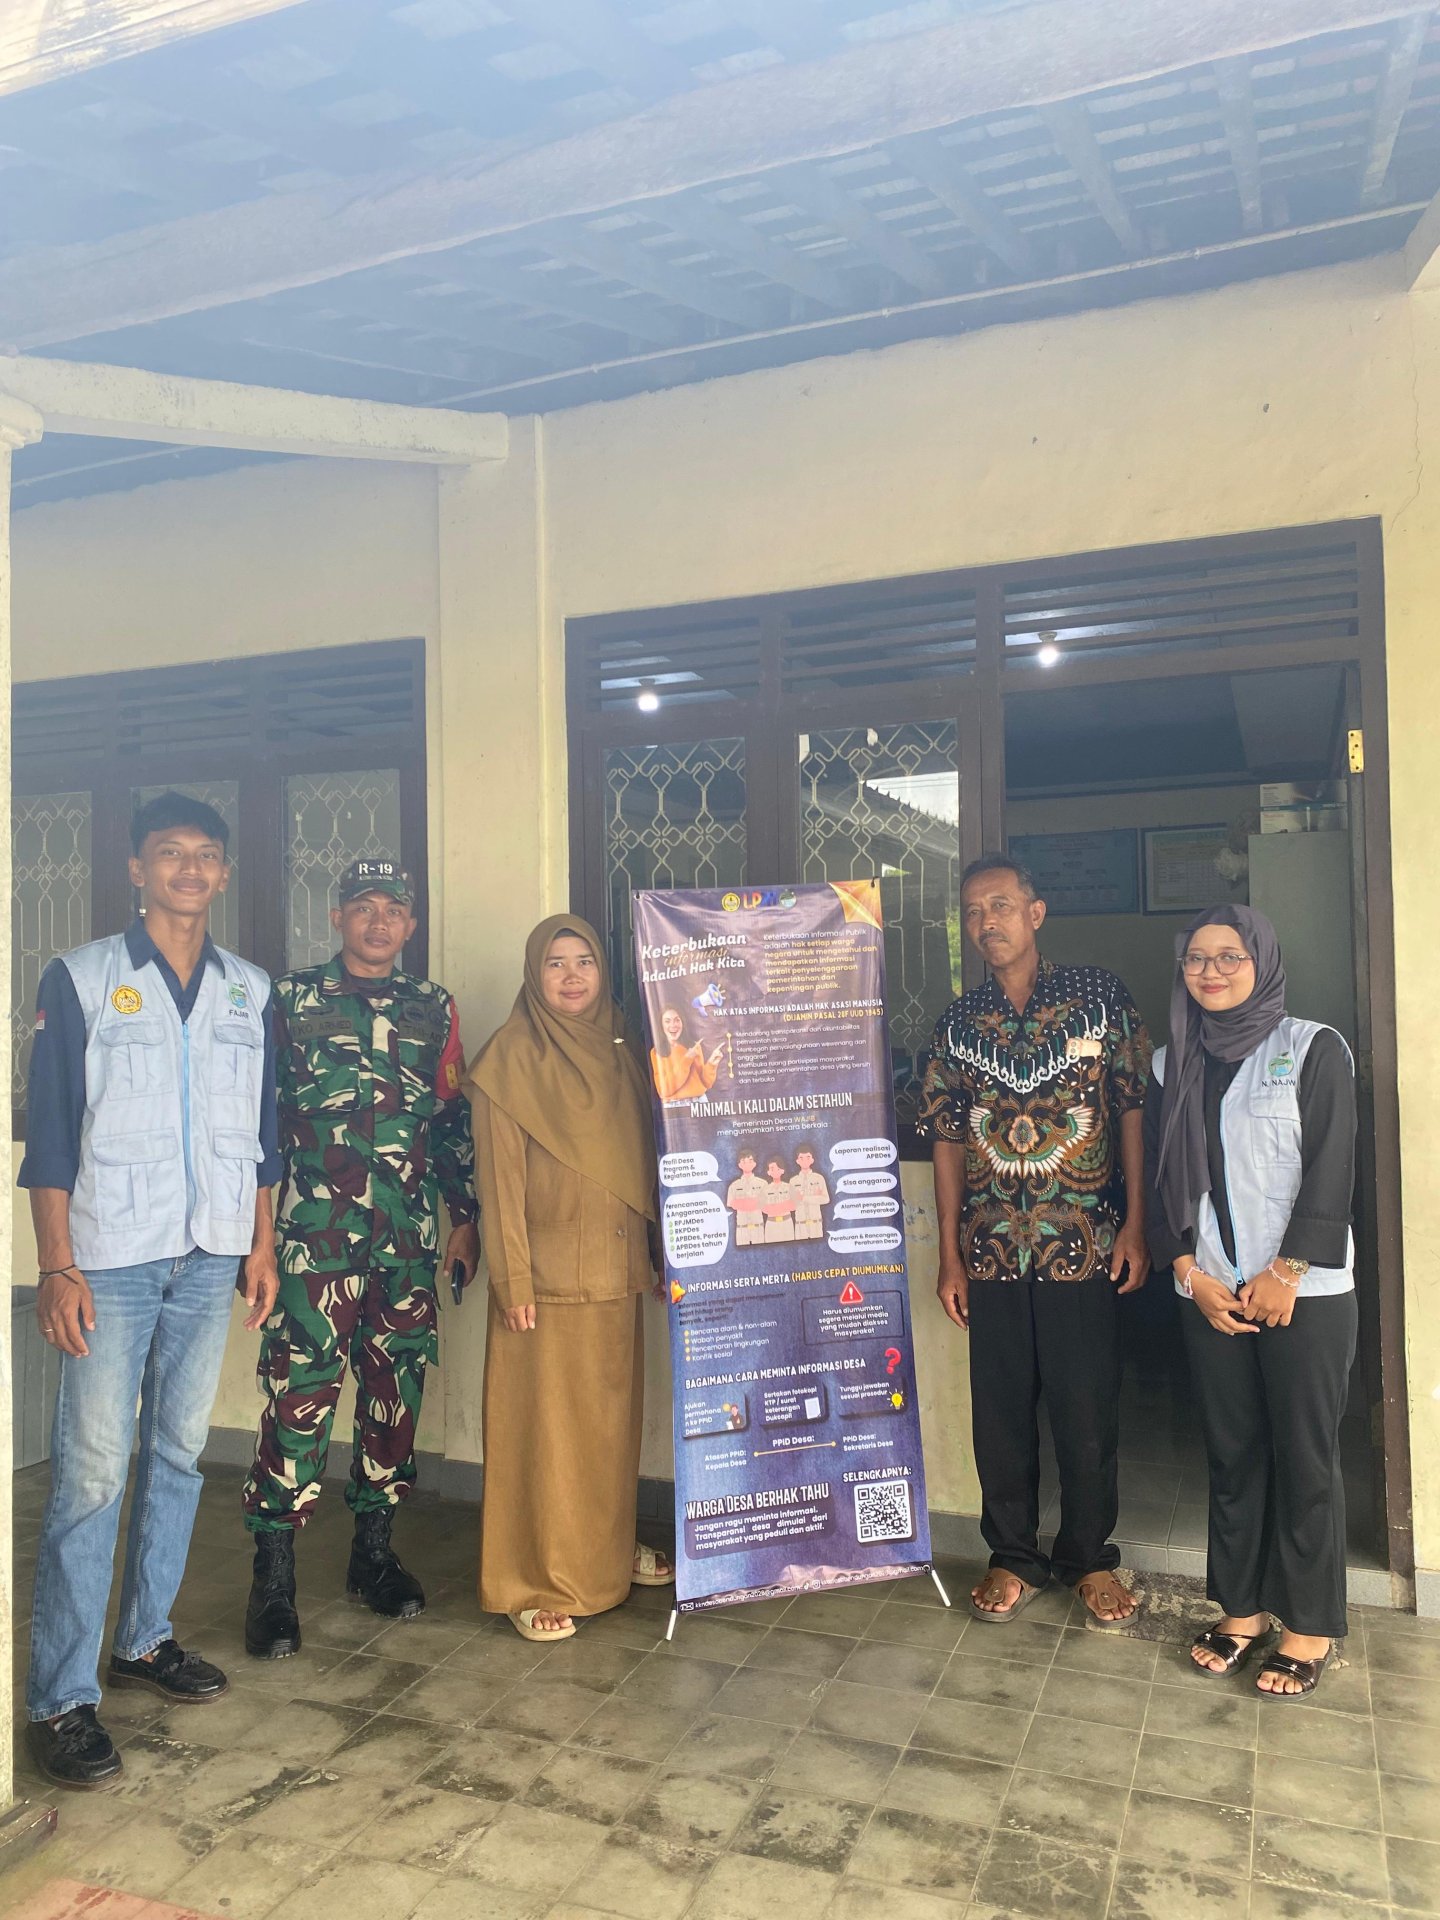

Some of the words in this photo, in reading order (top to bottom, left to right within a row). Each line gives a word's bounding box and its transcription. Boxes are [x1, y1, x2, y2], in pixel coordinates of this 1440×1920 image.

[358, 863, 393, 874] R-19
[764, 932, 809, 941] Keterbukaan
[642, 933, 746, 960] Keterbukaan
[664, 947, 729, 968] informasi
[765, 951, 791, 959] negara
[766, 958, 818, 968] mendapatkan
[820, 955, 855, 963] informasi
[642, 964, 686, 982] Adalah
[690, 960, 714, 974] Hak
[717, 957, 745, 968] Kita
[768, 984, 814, 994] kepentingan
[816, 983, 840, 991] publik.
[713, 1008, 728, 1016] HAK
[730, 1007, 747, 1015] ATAS
[749, 1004, 786, 1014] INFORMASI
[787, 1003, 814, 1012] ADALAH
[815, 1002, 830, 1010] HAK
[831, 1000, 851, 1009] ASASI
[852, 998, 883, 1008] MANUSIA
[229, 1010, 249, 1018] FAJAR
[814, 1012, 836, 1020] PASAL
[850, 1010, 864, 1018] UUD
[690, 1102, 734, 1118] MINIMAL
[745, 1099, 767, 1114] KALI
[770, 1096, 804, 1112] DALAM
[806, 1092, 852, 1108] SETAHUN
[733, 1118, 773, 1128] Pemerintah
[775, 1117, 792, 1125] Desa
[717, 1125, 774, 1136] mengumumkan
[776, 1124, 800, 1132] secara
[801, 1122, 828, 1130] berkala
[835, 1147, 861, 1156] Laporan
[664, 1172, 690, 1180] Kegiatan
[858, 1178, 891, 1186] anggaran
[666, 1201, 707, 1209] Perencanaan
[676, 1243, 701, 1251] APBDes
[676, 1251, 704, 1259] berjalan
[688, 1281, 732, 1293] INFORMASI
[734, 1277, 760, 1288] SERTA
[762, 1274, 790, 1284] MERTA
[792, 1271, 823, 1283] (HARUS
[824, 1268, 850, 1279] CEPAT
[852, 1264, 904, 1276] DIUMUMKAN)
[823, 1308, 842, 1316] Harus
[843, 1304, 883, 1313] diumumkan
[819, 1316, 841, 1324] segera
[842, 1313, 866, 1321] melalui
[691, 1328, 719, 1336] Bencana
[745, 1321, 777, 1329] non-alam
[820, 1324, 837, 1332] yang
[863, 1319, 888, 1327] diakses
[716, 1333, 743, 1342] penyakit
[835, 1328, 874, 1337] masyarakat
[691, 1343, 732, 1353] Pencemaran
[734, 1338, 769, 1349] lingkungan
[692, 1353, 712, 1361] Konflik
[714, 1350, 732, 1358] sosial
[686, 1374, 734, 1389] BAGAIMANA
[735, 1371, 758, 1383] CARA
[760, 1367, 797, 1380] MEMINTA
[798, 1360, 842, 1375] INFORMASI
[843, 1358, 866, 1369] DESA
[764, 1390, 792, 1398] Sertakan
[792, 1386, 817, 1395] fotokopi
[840, 1385, 862, 1394] Tunggu
[863, 1382, 889, 1391] jawaban
[841, 1392, 860, 1400] sesuai
[860, 1389, 887, 1399] prosedur
[684, 1402, 705, 1411] Ajukan
[765, 1405, 800, 1414] keterangan
[685, 1408, 721, 1419] permohona
[685, 1428, 700, 1436] Desa
[773, 1439, 790, 1447] PPID
[792, 1436, 815, 1445] Desa:
[844, 1444, 876, 1452] Sekretaris
[705, 1463, 729, 1471] Kepala
[843, 1467, 912, 1483] SELENGKAPNYA:
[686, 1500, 725, 1520] WARGA
[726, 1494, 752, 1513] DESA
[756, 1488, 799, 1508] BERHAK
[800, 1483, 829, 1500] TAHU
[695, 1521, 724, 1533] Jangan
[725, 1519, 743, 1529] ragu
[744, 1512, 779, 1523] meminta
[780, 1506, 818, 1518] informasi.
[695, 1526, 746, 1542] Transparansi
[752, 1522, 770, 1532] desa
[776, 1518, 806, 1527] dimulai
[812, 1513, 828, 1522] dari
[696, 1536, 743, 1551] masyarakat
[744, 1533, 763, 1544] yang
[764, 1528, 788, 1541] peduli
[789, 1526, 804, 1535] dan
[805, 1522, 824, 1532] aktif.
